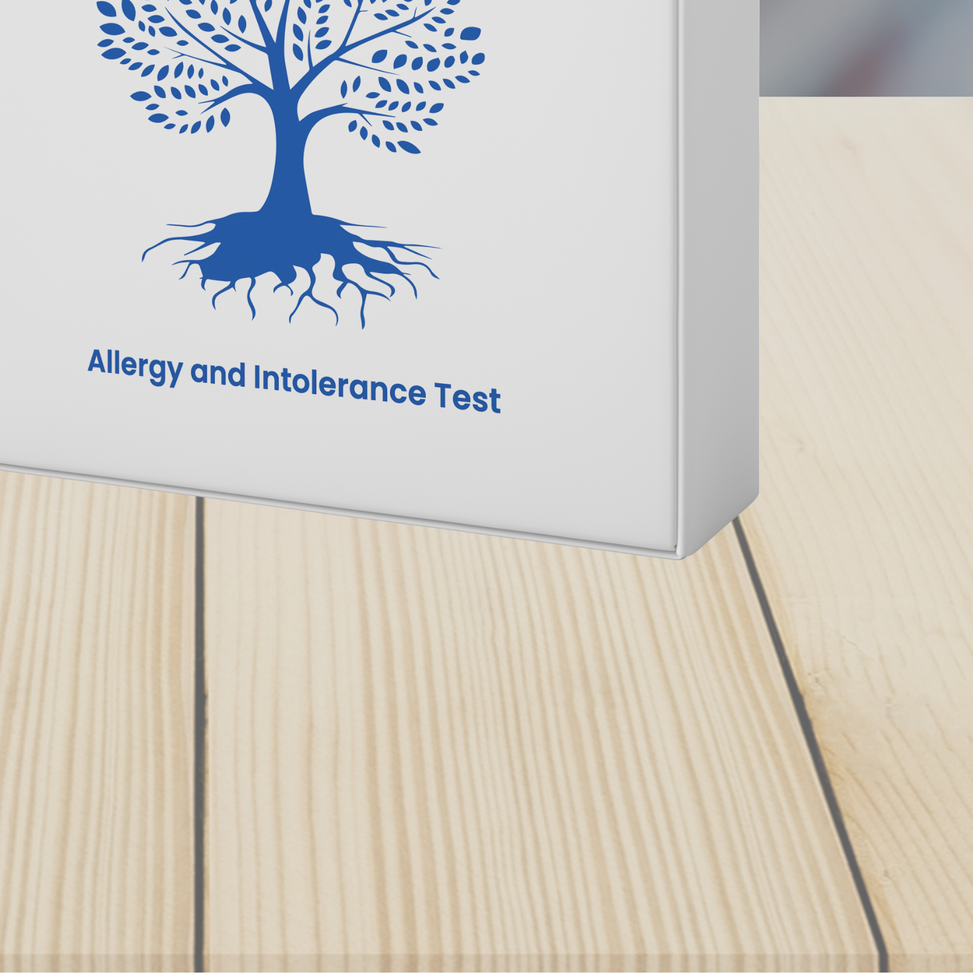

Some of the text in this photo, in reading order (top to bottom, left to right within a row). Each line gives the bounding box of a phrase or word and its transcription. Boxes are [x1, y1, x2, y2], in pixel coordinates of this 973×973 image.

[87, 349, 501, 414] Allergy and Intolerance Test
